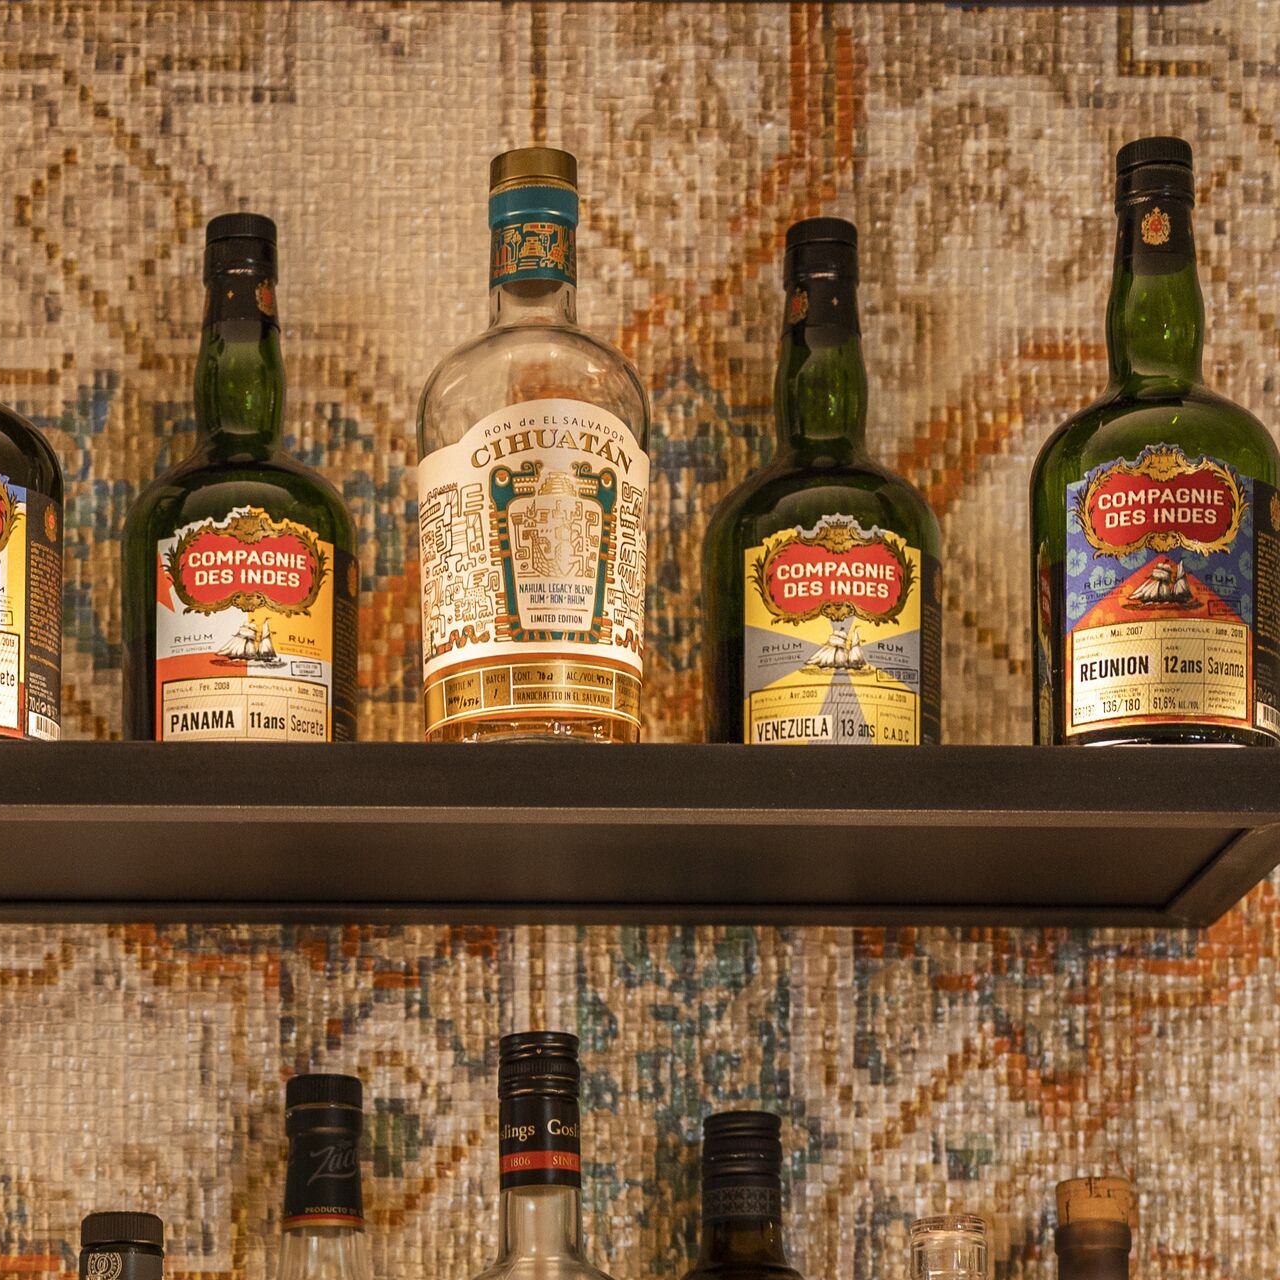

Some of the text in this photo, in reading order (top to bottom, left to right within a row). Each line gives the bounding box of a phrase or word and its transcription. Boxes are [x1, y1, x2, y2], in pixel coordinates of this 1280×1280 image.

[484, 415, 625, 443] RON de EL SALVADOR
[470, 429, 633, 475] CIHUATÁN
[1098, 487, 1224, 510] COMPAGNIE
[1105, 507, 1217, 529] DES INDES
[188, 550, 307, 571] COMPAGNIE
[195, 569, 300, 588] DES INDES
[776, 562, 896, 581] COMPAGNIE
[1204, 574, 1235, 584] RUM
[519, 583, 594, 595] NAHUAL LEGACY BLEND
[784, 580, 889, 599] DES INDES
[1084, 576, 1125, 590] RHUM
[530, 614, 583, 624] LIMITED EDITION
[174, 633, 213, 644] RHUM
[288, 634, 315, 646] RUM
[1126, 626, 1143, 636] 2007
[762, 641, 803, 654] RHUM
[877, 642, 904, 653] RUM
[1080, 655, 1149, 683] REUNION
[1164, 656, 1203, 674] 12 ans
[1208, 656, 1244, 678] Savanna
[486, 673, 506, 685] BATCH
[516, 690, 562, 702] HANDCRAFTED
[564, 690, 571, 701] IN
[572, 691, 580, 702] EL
[1102, 698, 1141, 713] 136/180
[170, 709, 235, 733] PANAMA
[249, 711, 286, 730] 11 ans
[290, 714, 324, 737] Secrete
[757, 717, 829, 742] VENEZUELA
[840, 718, 876, 738] 13 ans
[509, 1155, 532, 1168] 1806
[304, 1206, 348, 1214] PRODUCTO
